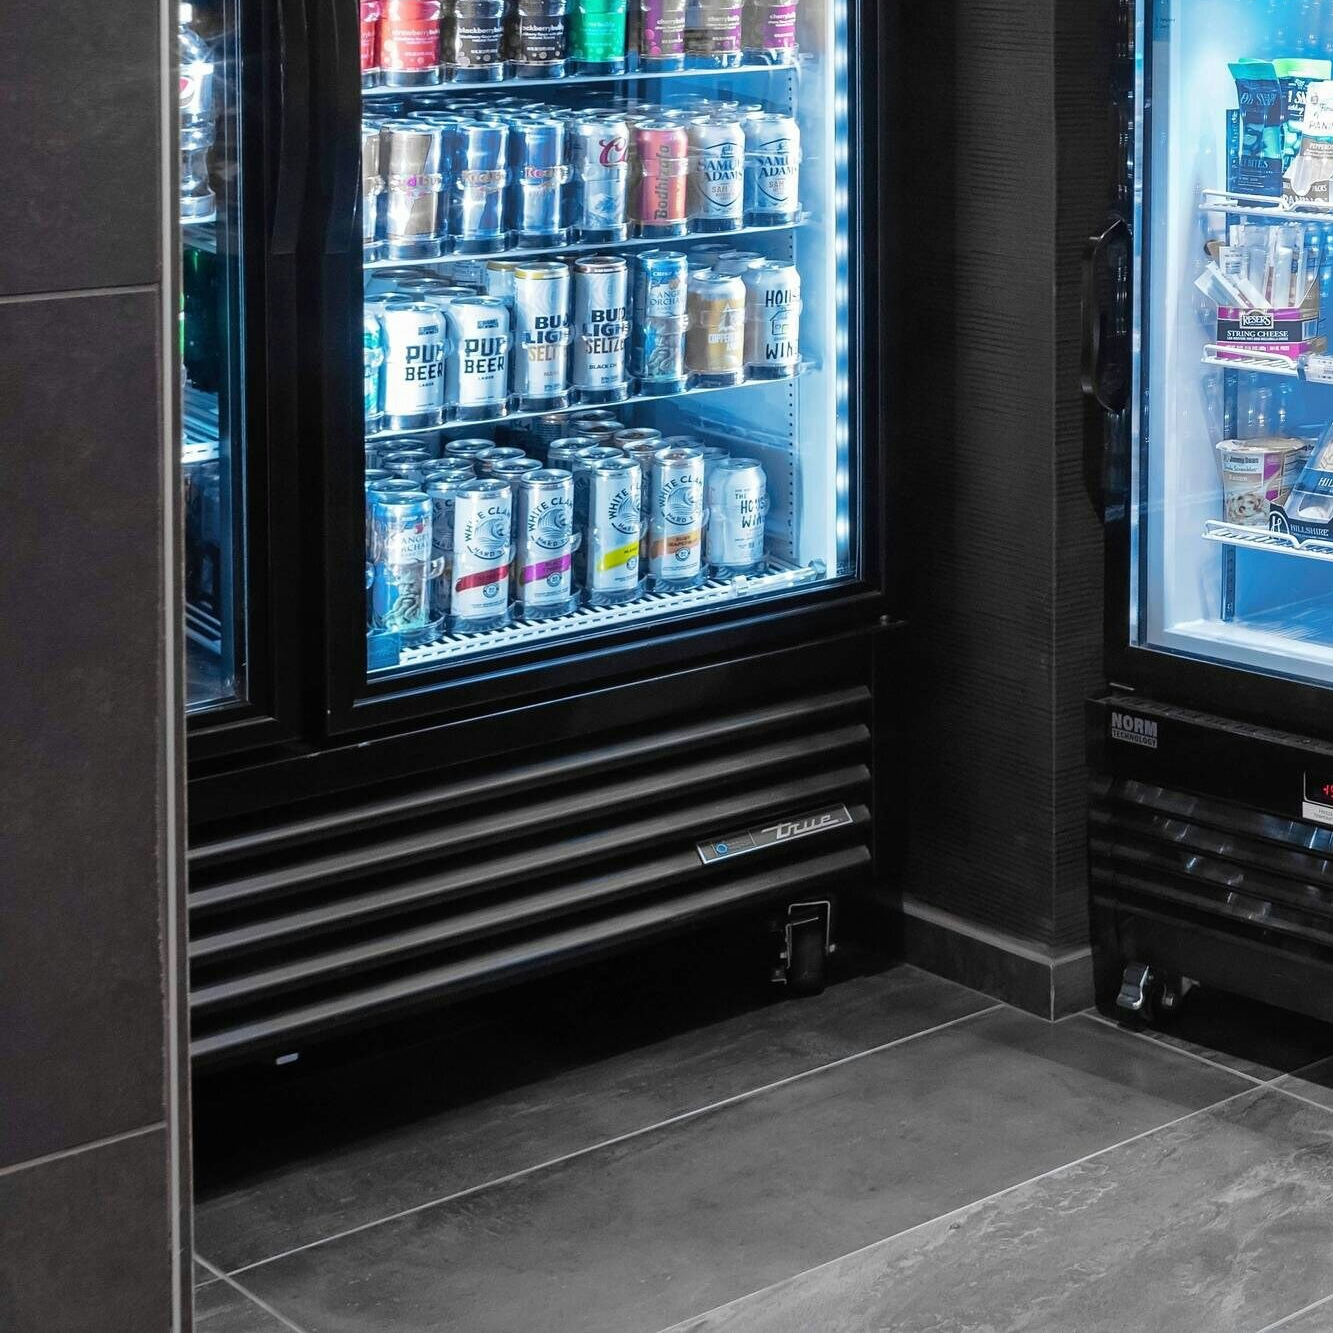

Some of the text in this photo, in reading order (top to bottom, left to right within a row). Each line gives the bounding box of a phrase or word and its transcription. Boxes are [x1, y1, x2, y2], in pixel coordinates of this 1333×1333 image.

[1227, 330, 1290, 339] STRING CHEESE
[405, 362, 444, 381] BEER
[464, 356, 505, 374] BEER
[609, 488, 629, 520] WHITE
[658, 478, 678, 508] WHITE
[1111, 712, 1158, 738] NORM
